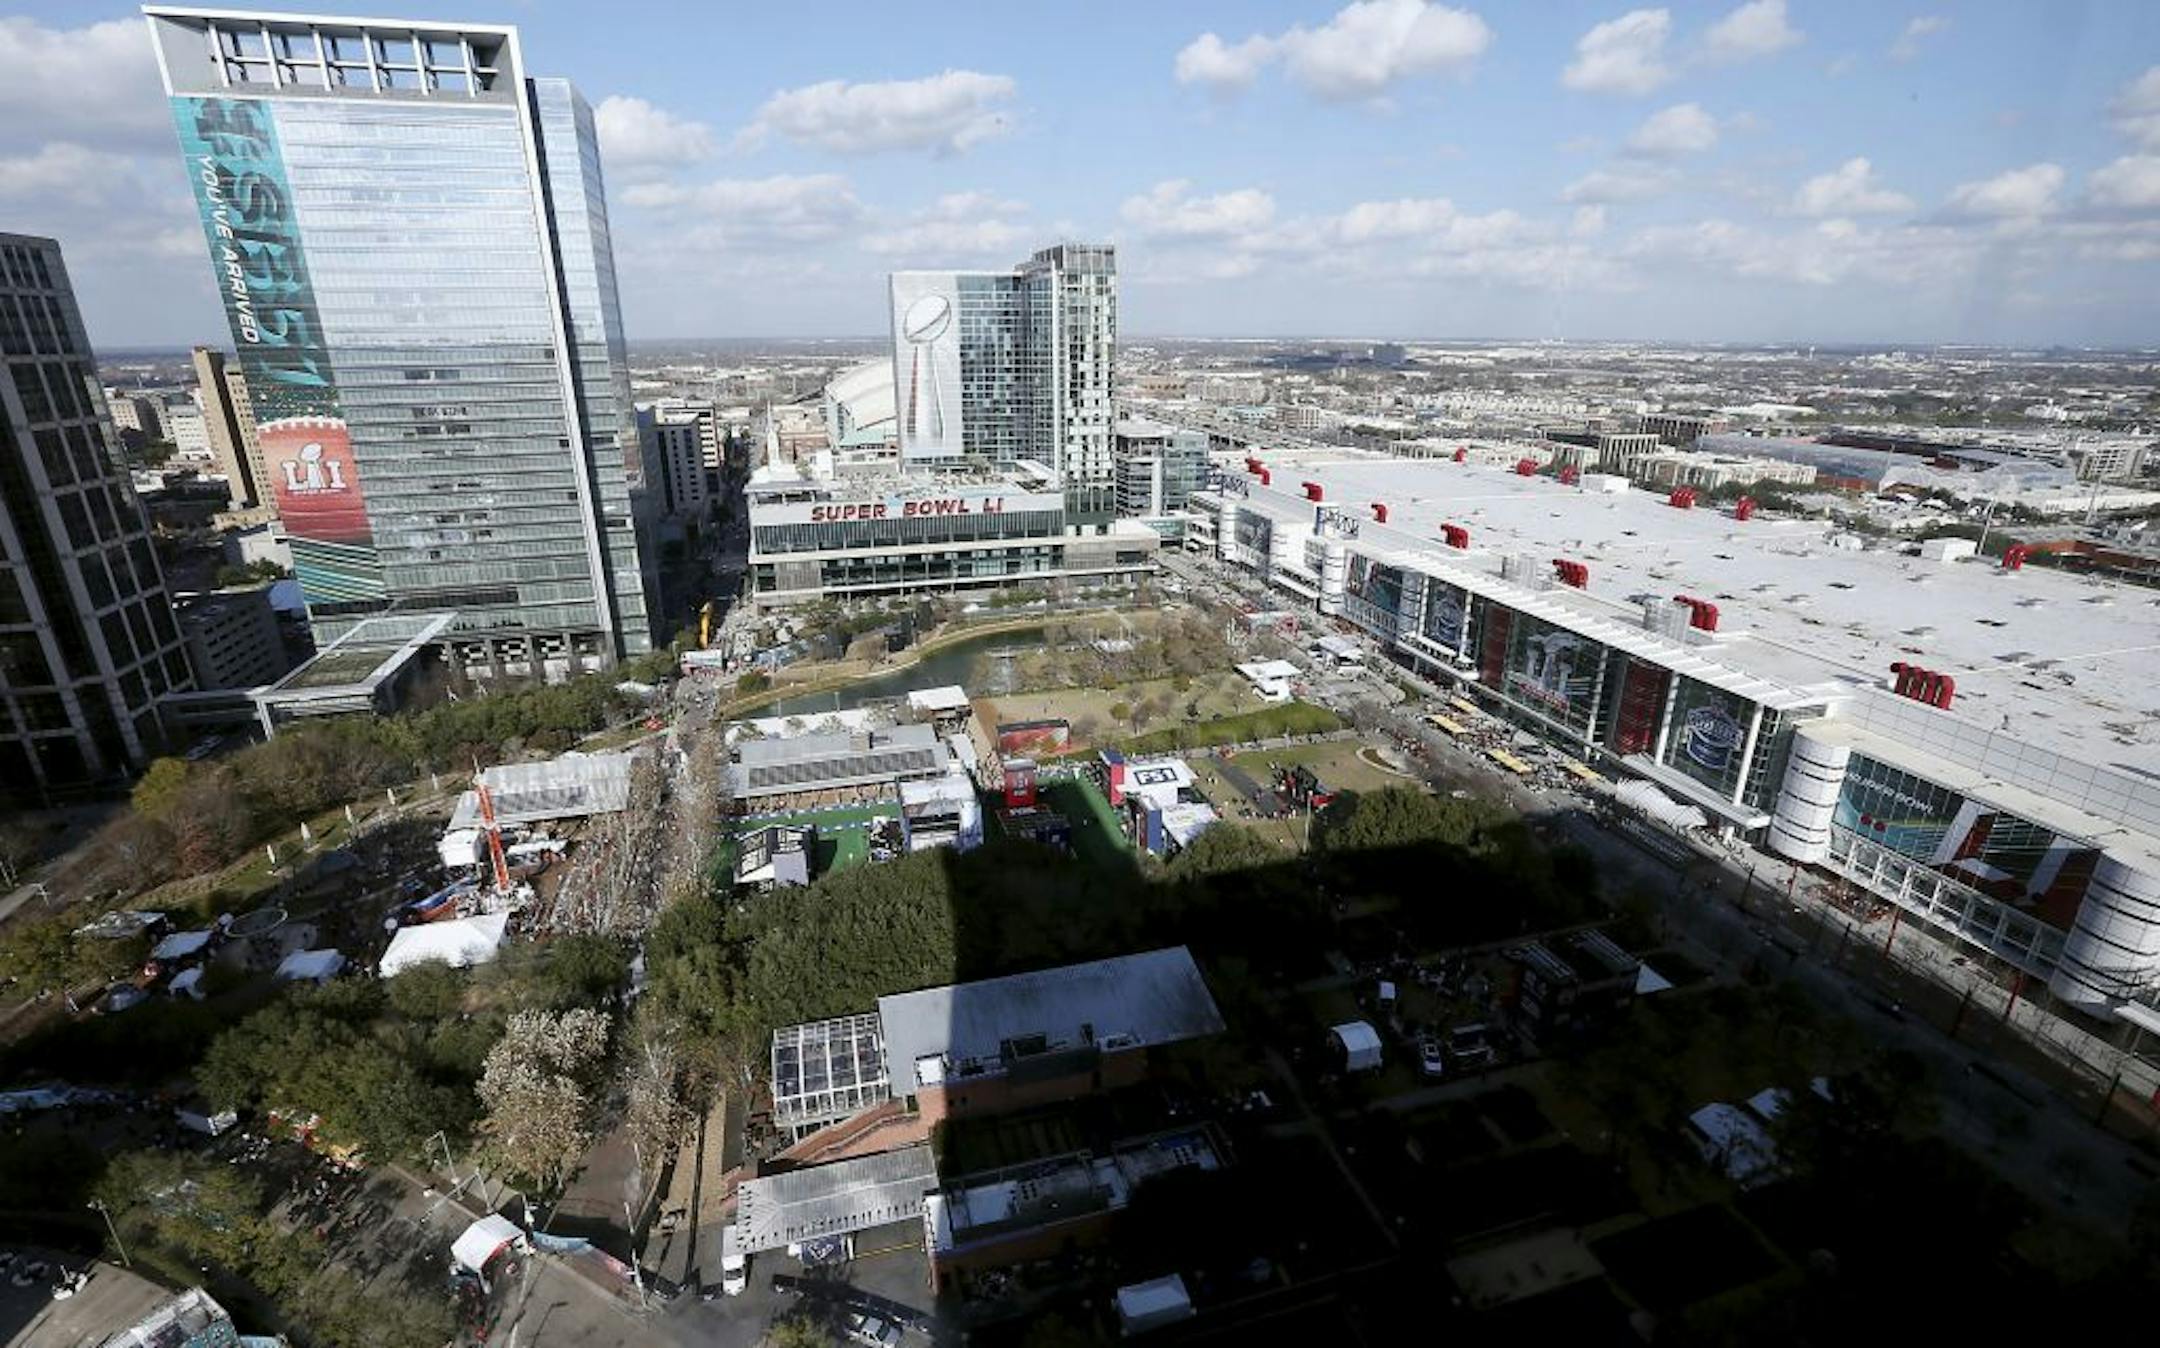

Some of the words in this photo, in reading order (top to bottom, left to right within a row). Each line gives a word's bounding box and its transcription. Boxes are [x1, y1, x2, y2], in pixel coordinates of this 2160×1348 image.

[198, 155, 233, 239] YOU'VE
[221, 245, 260, 345] ARRIVED
[811, 504, 887, 521] SUPER
[902, 500, 969, 516] BOWL
[983, 498, 1004, 512] LI
